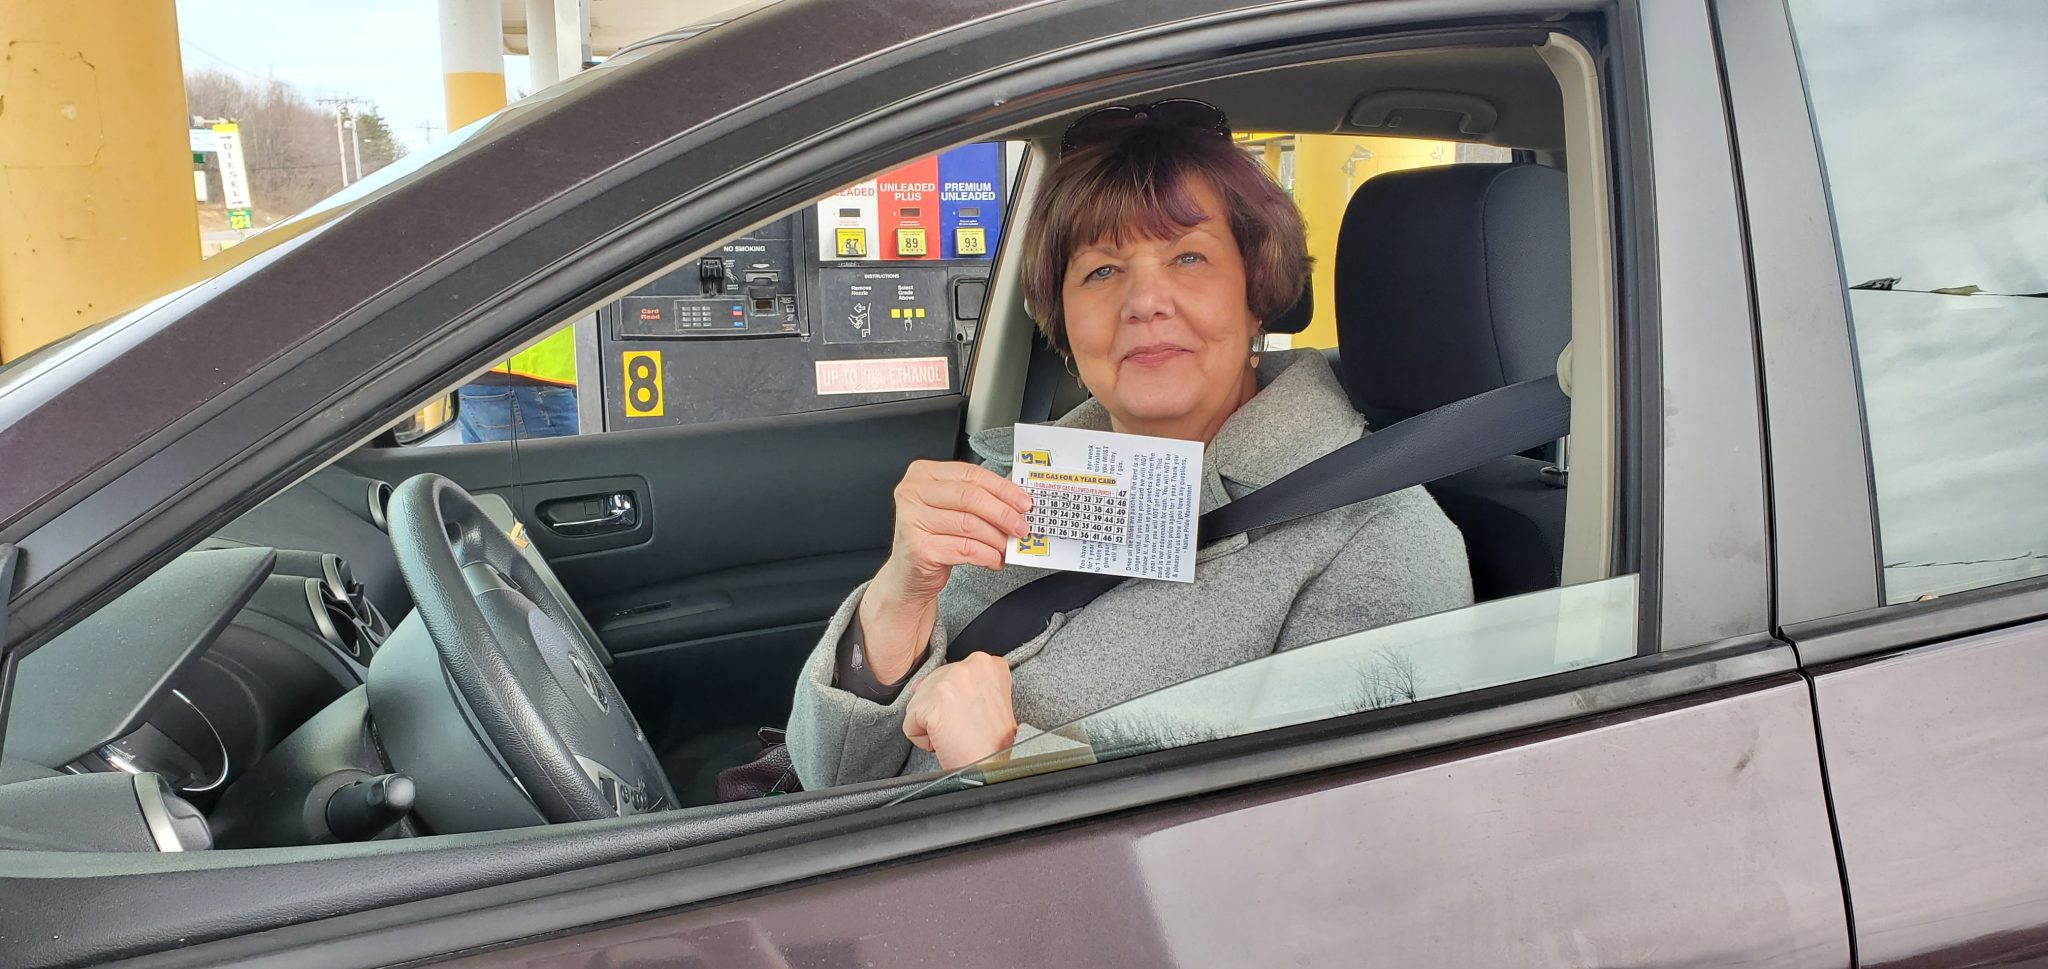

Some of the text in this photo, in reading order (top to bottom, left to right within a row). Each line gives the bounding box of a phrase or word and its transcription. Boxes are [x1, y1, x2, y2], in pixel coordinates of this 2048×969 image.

[224, 143, 240, 197] DIESEL
[880, 183, 936, 192] UNLEADED
[944, 183, 992, 192] PREMIUM
[894, 192, 922, 201] PLUS
[941, 192, 996, 201] UNLEADED
[845, 238, 859, 249] 87
[905, 237, 919, 249] 89
[964, 237, 978, 248] 93
[822, 369, 839, 386] UP
[841, 368, 858, 385] TO
[889, 366, 943, 383] ETHANOL
[628, 355, 659, 412] 8
